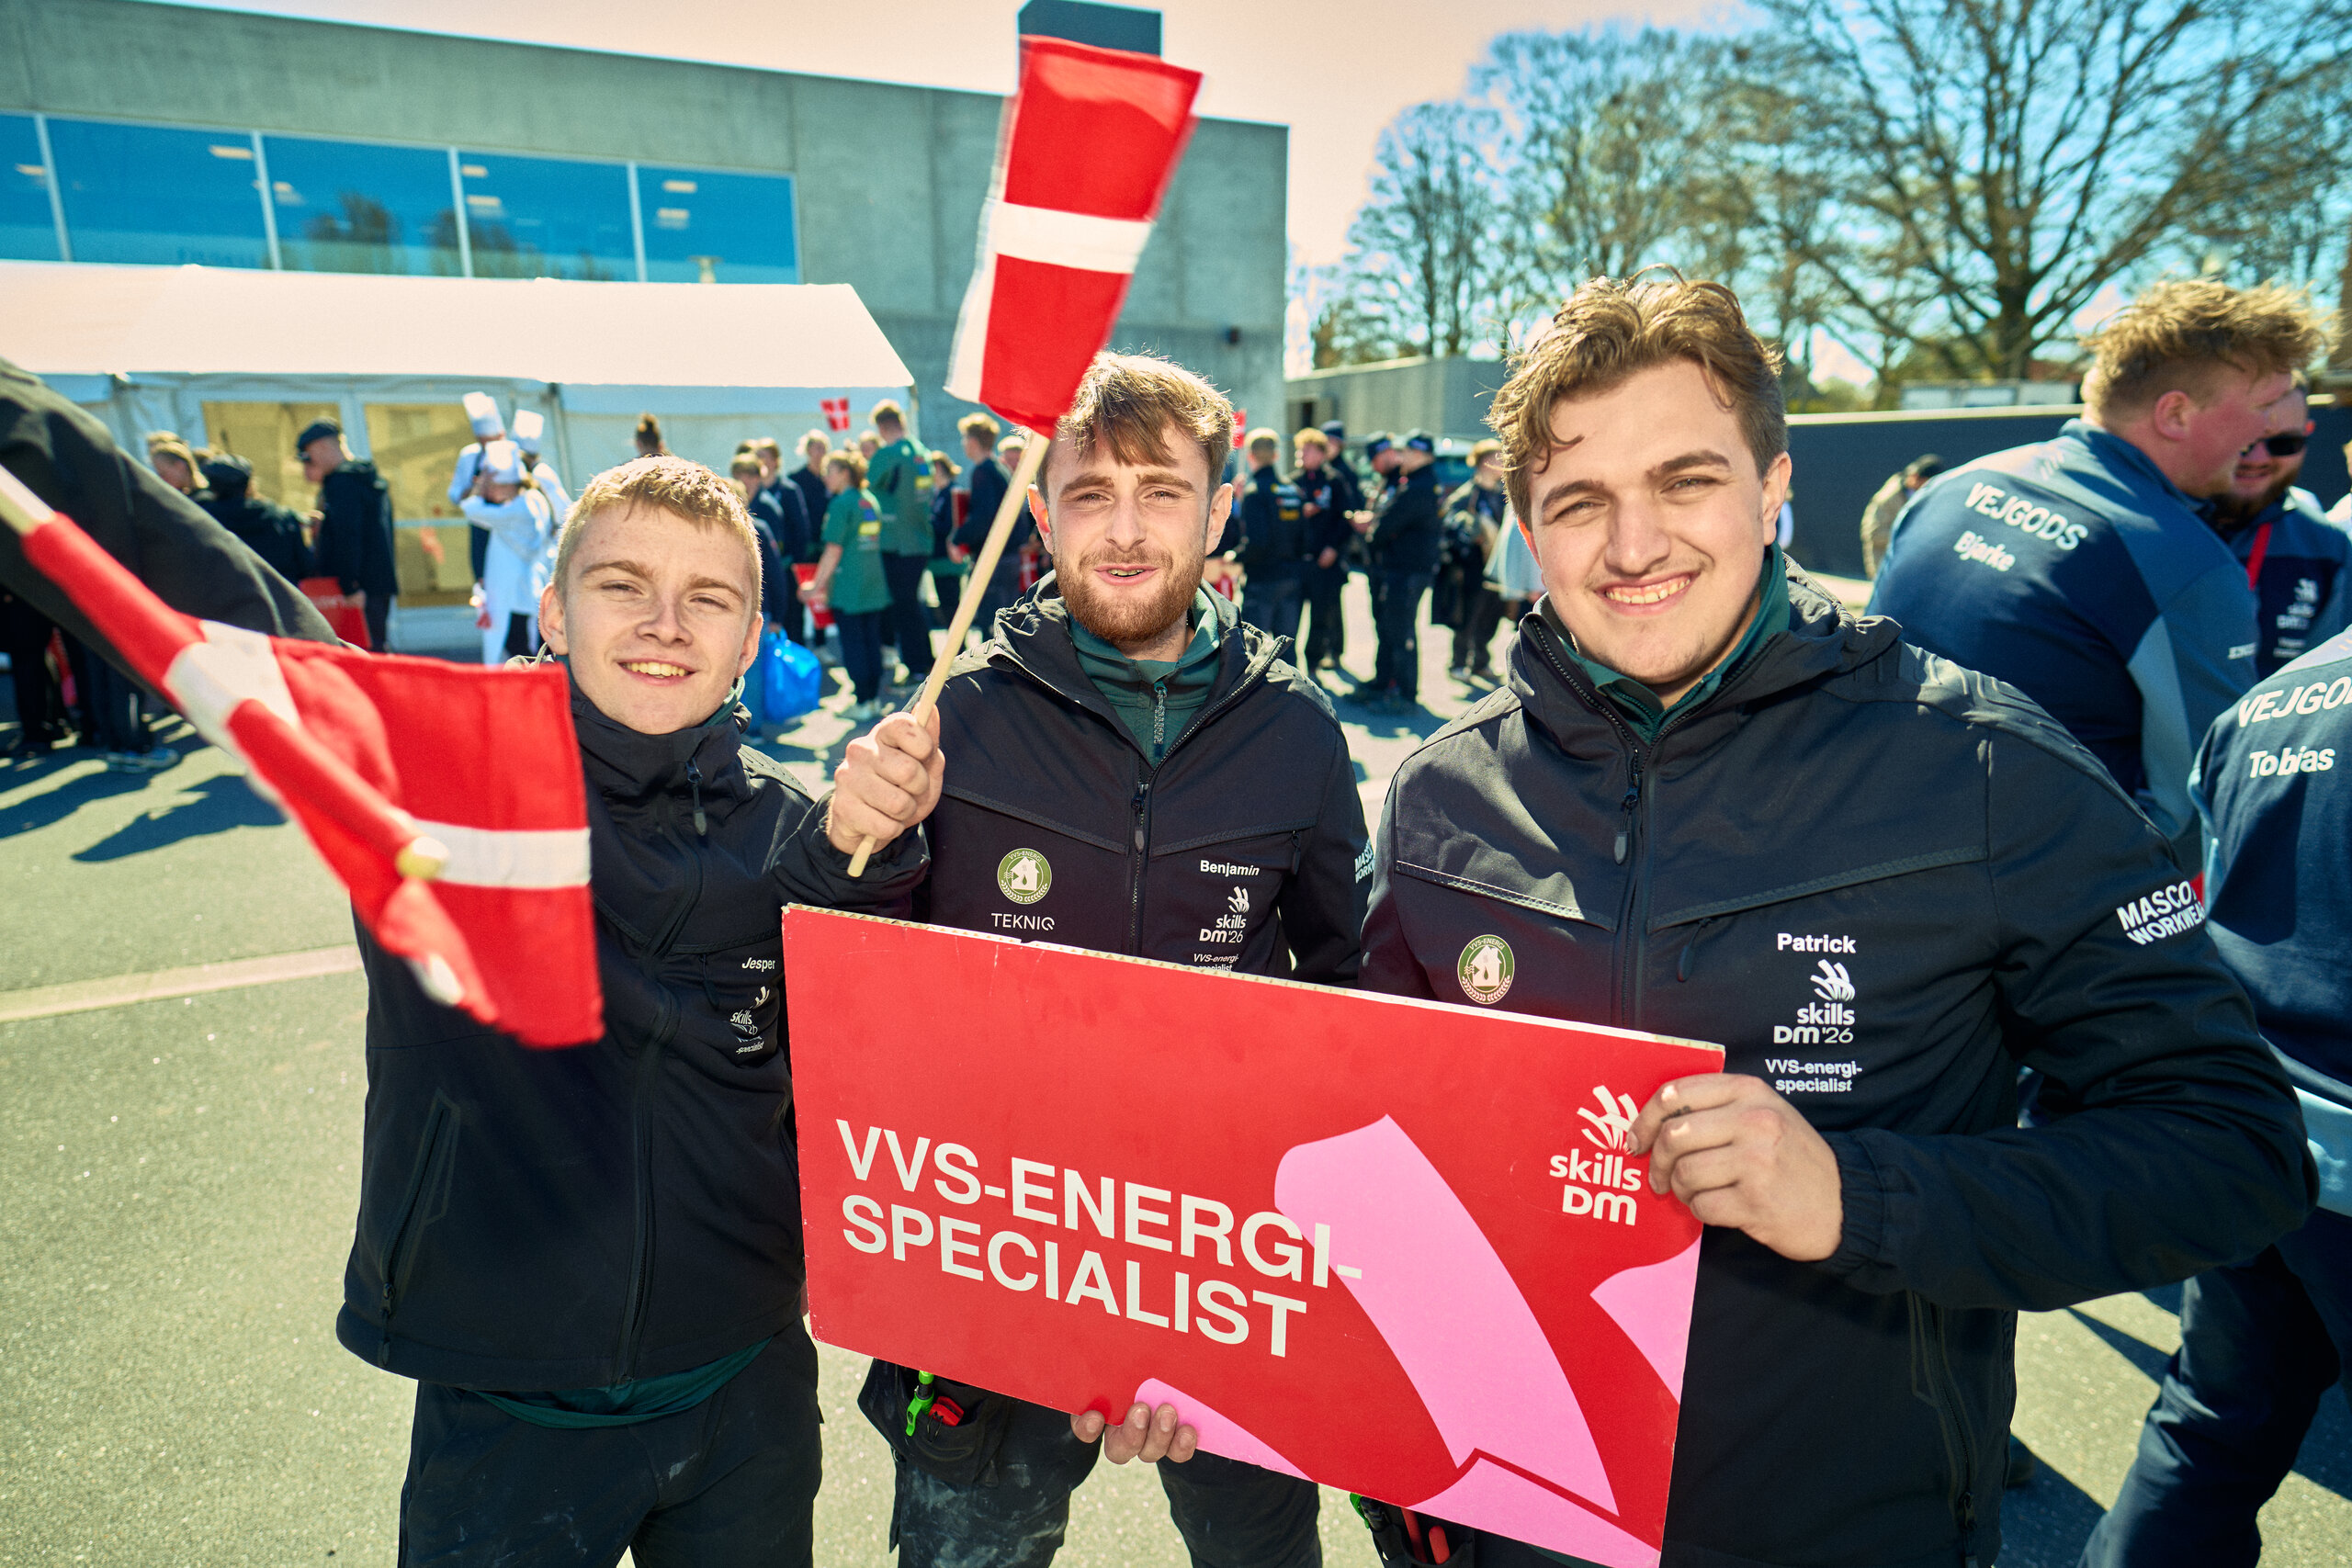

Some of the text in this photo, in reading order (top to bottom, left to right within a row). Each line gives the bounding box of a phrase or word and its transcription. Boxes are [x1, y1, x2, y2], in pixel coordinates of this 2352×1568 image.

[1964, 481, 2089, 551] VEJGODS
[1952, 529, 2017, 572] Bjarke
[2249, 745, 2336, 779] Tobias
[1200, 859, 1261, 877] Benjamin
[2116, 880, 2197, 931] MASCO
[990, 912, 1056, 931] TEKNIQ
[1216, 914, 1247, 929] skills
[1469, 938, 1506, 951] VVS-ENERGI
[1777, 932, 1857, 954] Patrick
[741, 957, 776, 973] Jesper
[1796, 1001, 1856, 1026] skills
[1764, 1058, 1863, 1078] VVS-energi-
[1775, 1077, 1853, 1095] specialist
[1549, 1148, 1642, 1191] skills
[835, 1118, 1363, 1289] VVS-ENERGI-
[842, 1194, 1307, 1358] SPECIALIST
